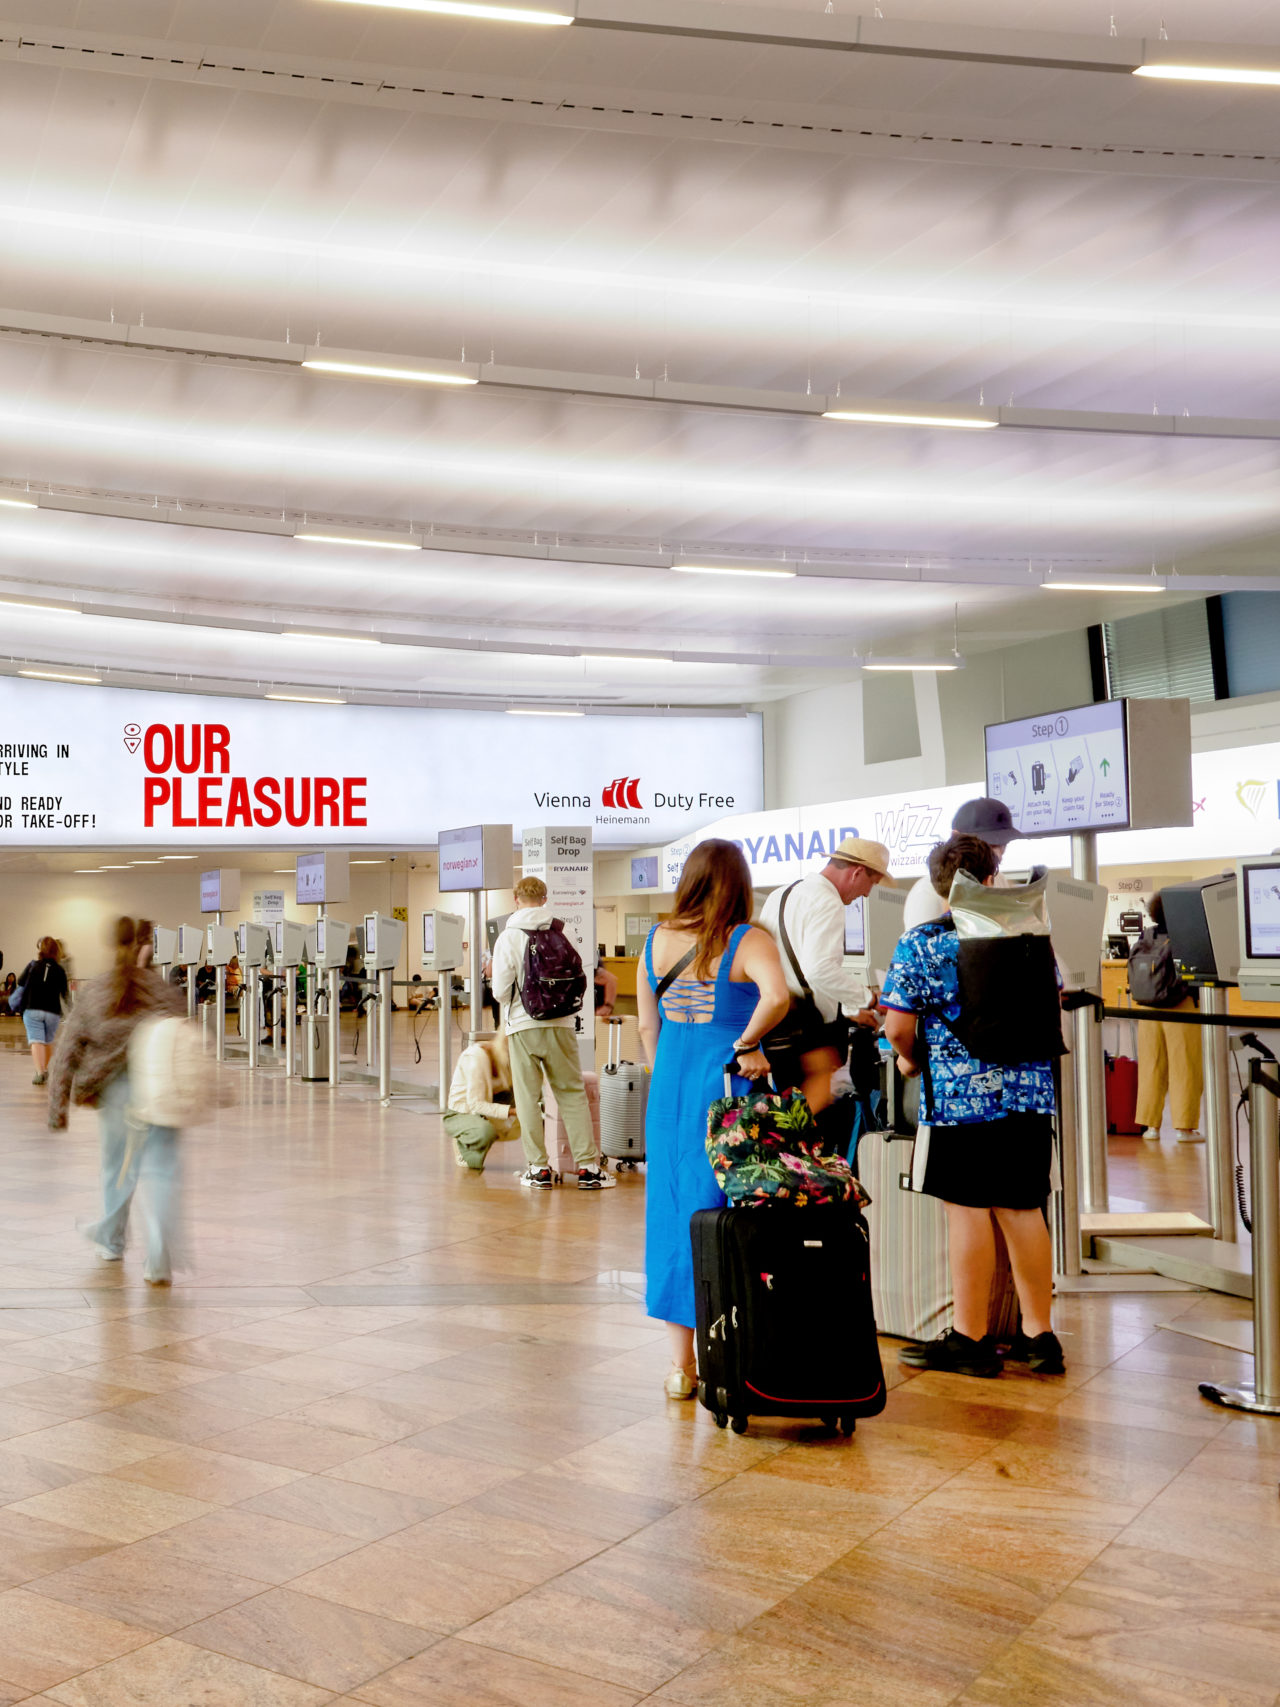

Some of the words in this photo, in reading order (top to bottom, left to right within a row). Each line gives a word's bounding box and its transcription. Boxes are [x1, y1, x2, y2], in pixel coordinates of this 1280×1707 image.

[1032, 723, 1053, 738] Step
[57, 744, 69, 758] IN
[144, 723, 231, 774] OUR
[21, 796, 63, 811] READY
[144, 776, 368, 828] PLEASURE
[534, 792, 591, 808] Vienna
[654, 793, 694, 811] Duty
[699, 793, 735, 808] Free
[21, 814, 96, 828] TAKE-OFF!
[595, 815, 650, 825] Heinemann
[525, 838, 533, 847] Self
[534, 837, 543, 847] Bag
[551, 835, 568, 845] Self
[570, 836, 586, 846] Bag
[528, 849, 539, 857] Drop
[557, 847, 580, 857] Drop
[671, 848, 682, 857] Step
[443, 858, 473, 871] norwegian
[667, 862, 679, 873] Self
[1118, 881, 1132, 891] Step
